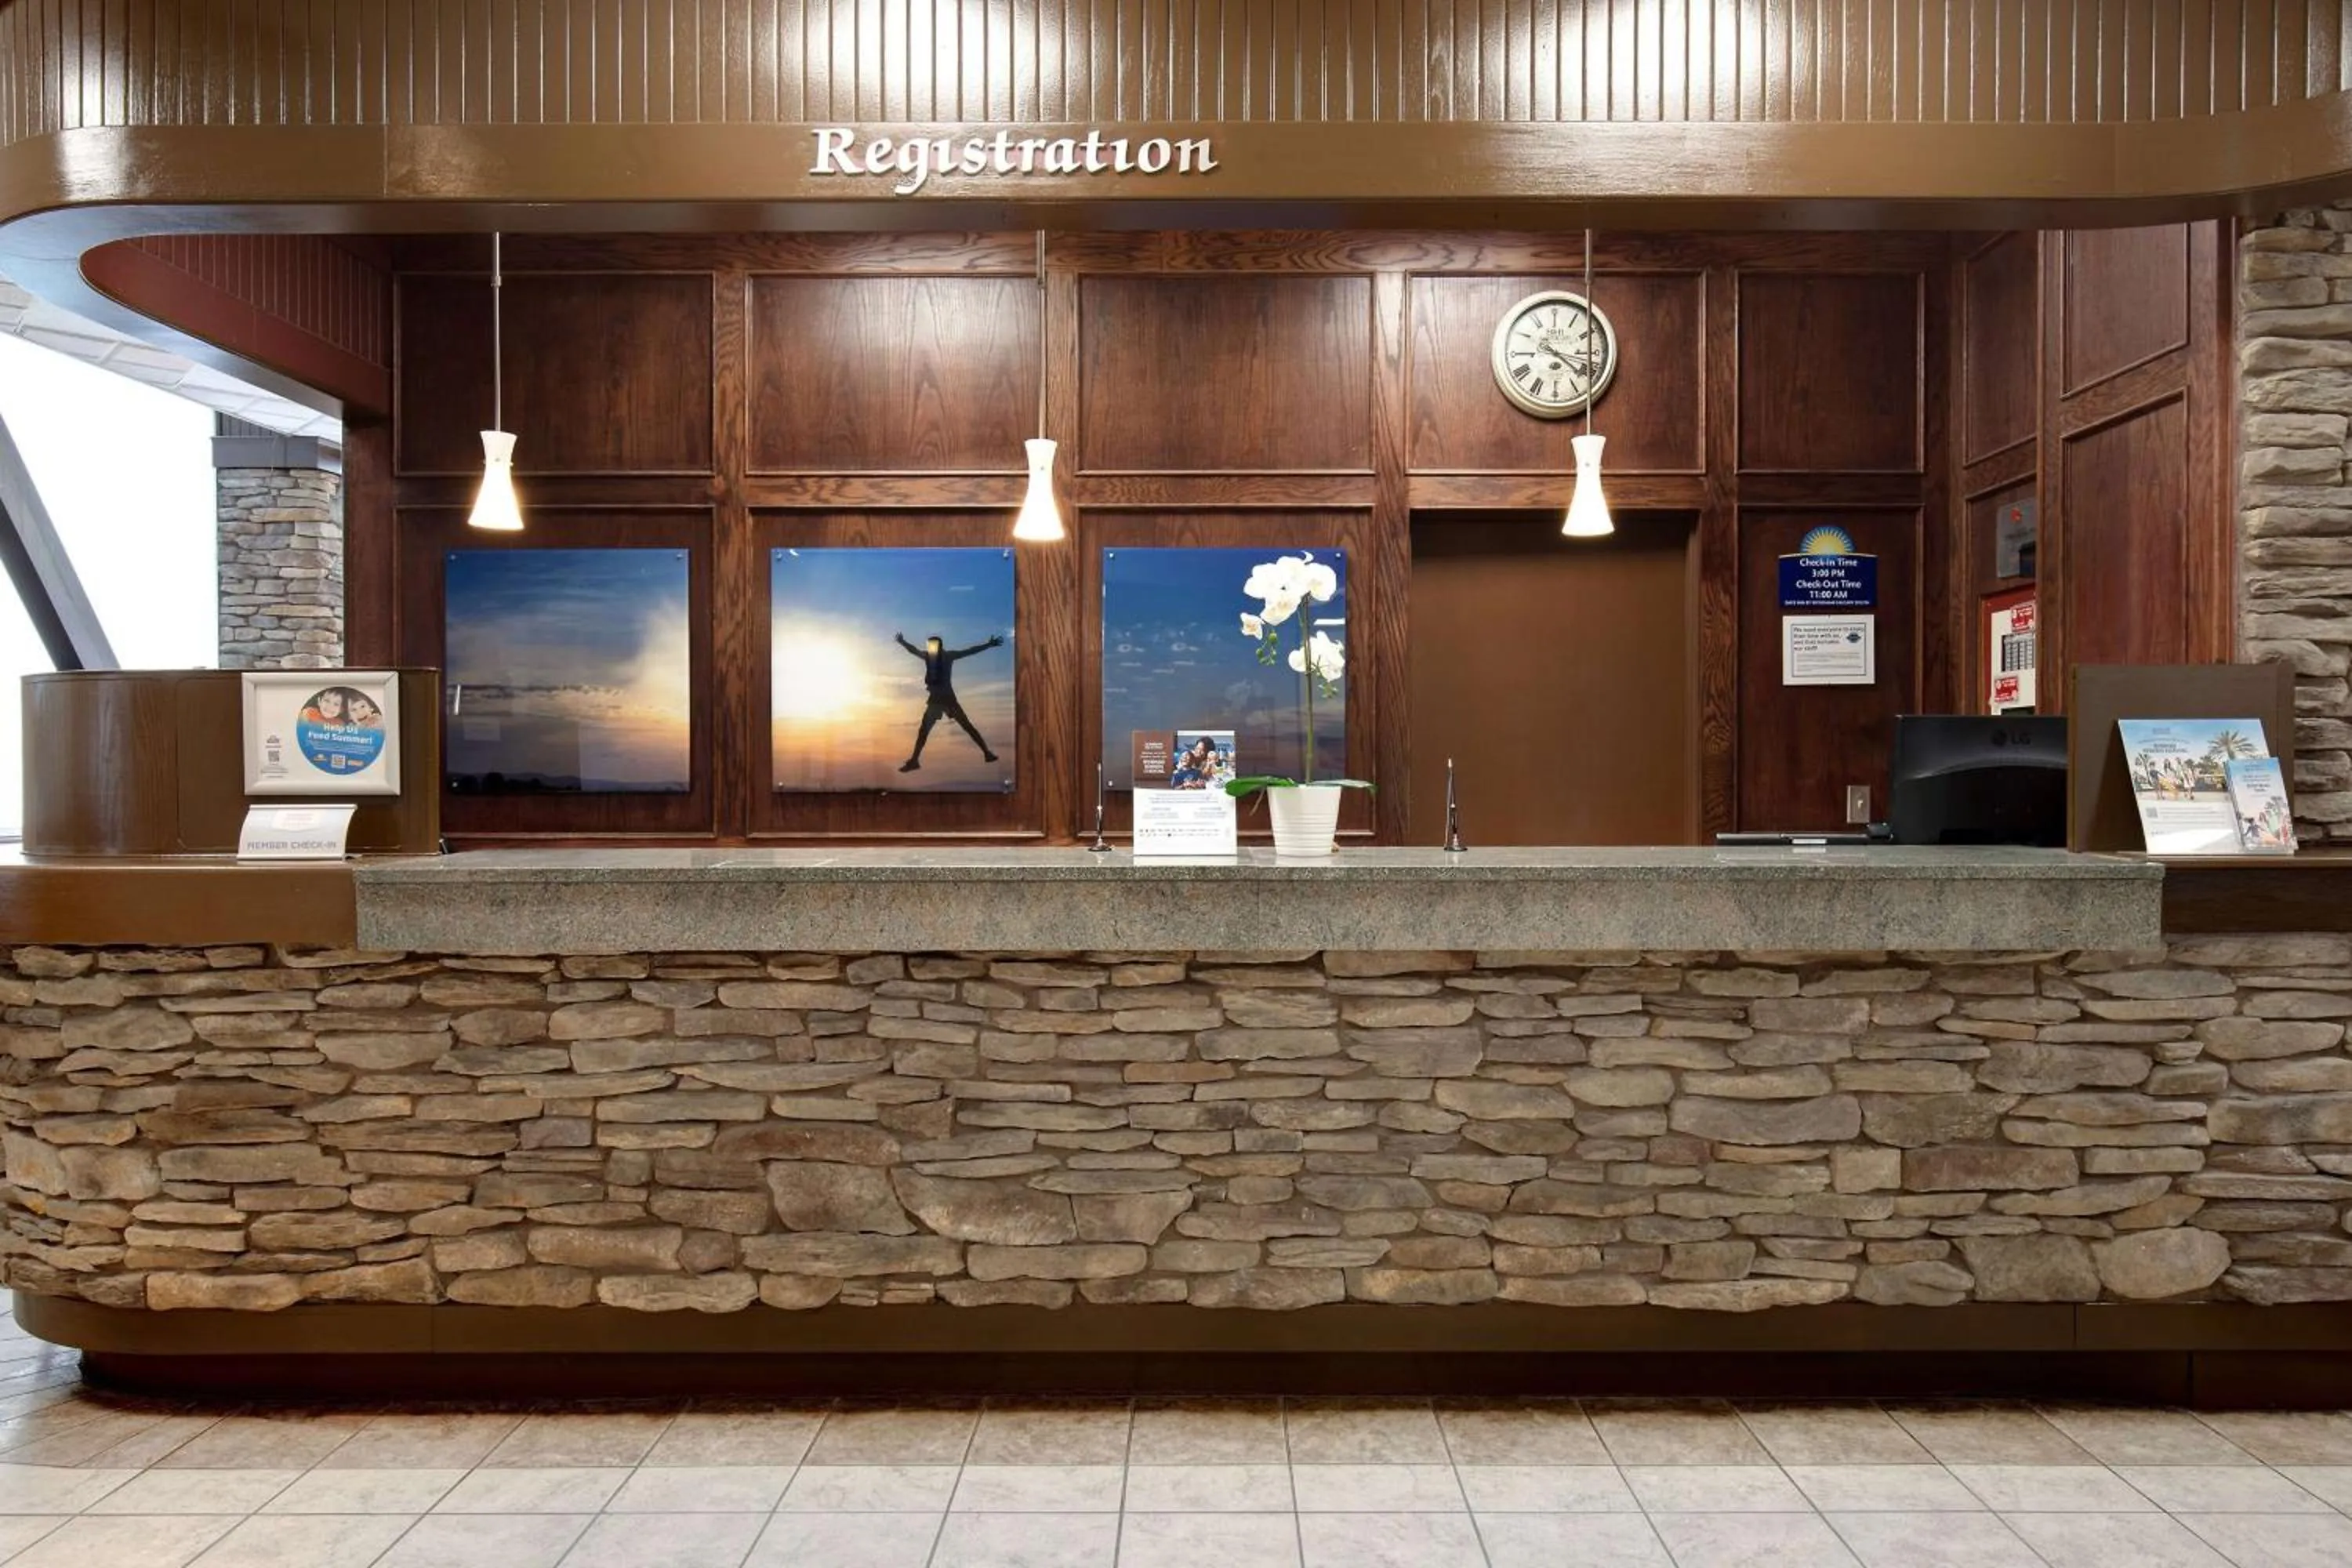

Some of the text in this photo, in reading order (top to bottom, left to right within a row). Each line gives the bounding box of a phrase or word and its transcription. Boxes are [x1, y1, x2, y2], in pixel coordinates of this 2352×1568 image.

[809, 128, 1219, 195] Registration
[1837, 558, 1857, 567] Time
[1812, 569, 1845, 578] 3:00 PM
[1841, 580, 1862, 589] Time
[1809, 590, 1848, 599] 11:00 AM
[324, 722, 358, 734] Help Us
[2010, 731, 2031, 745] LG
[247, 840, 336, 850] MEMBER CHECK-IN
